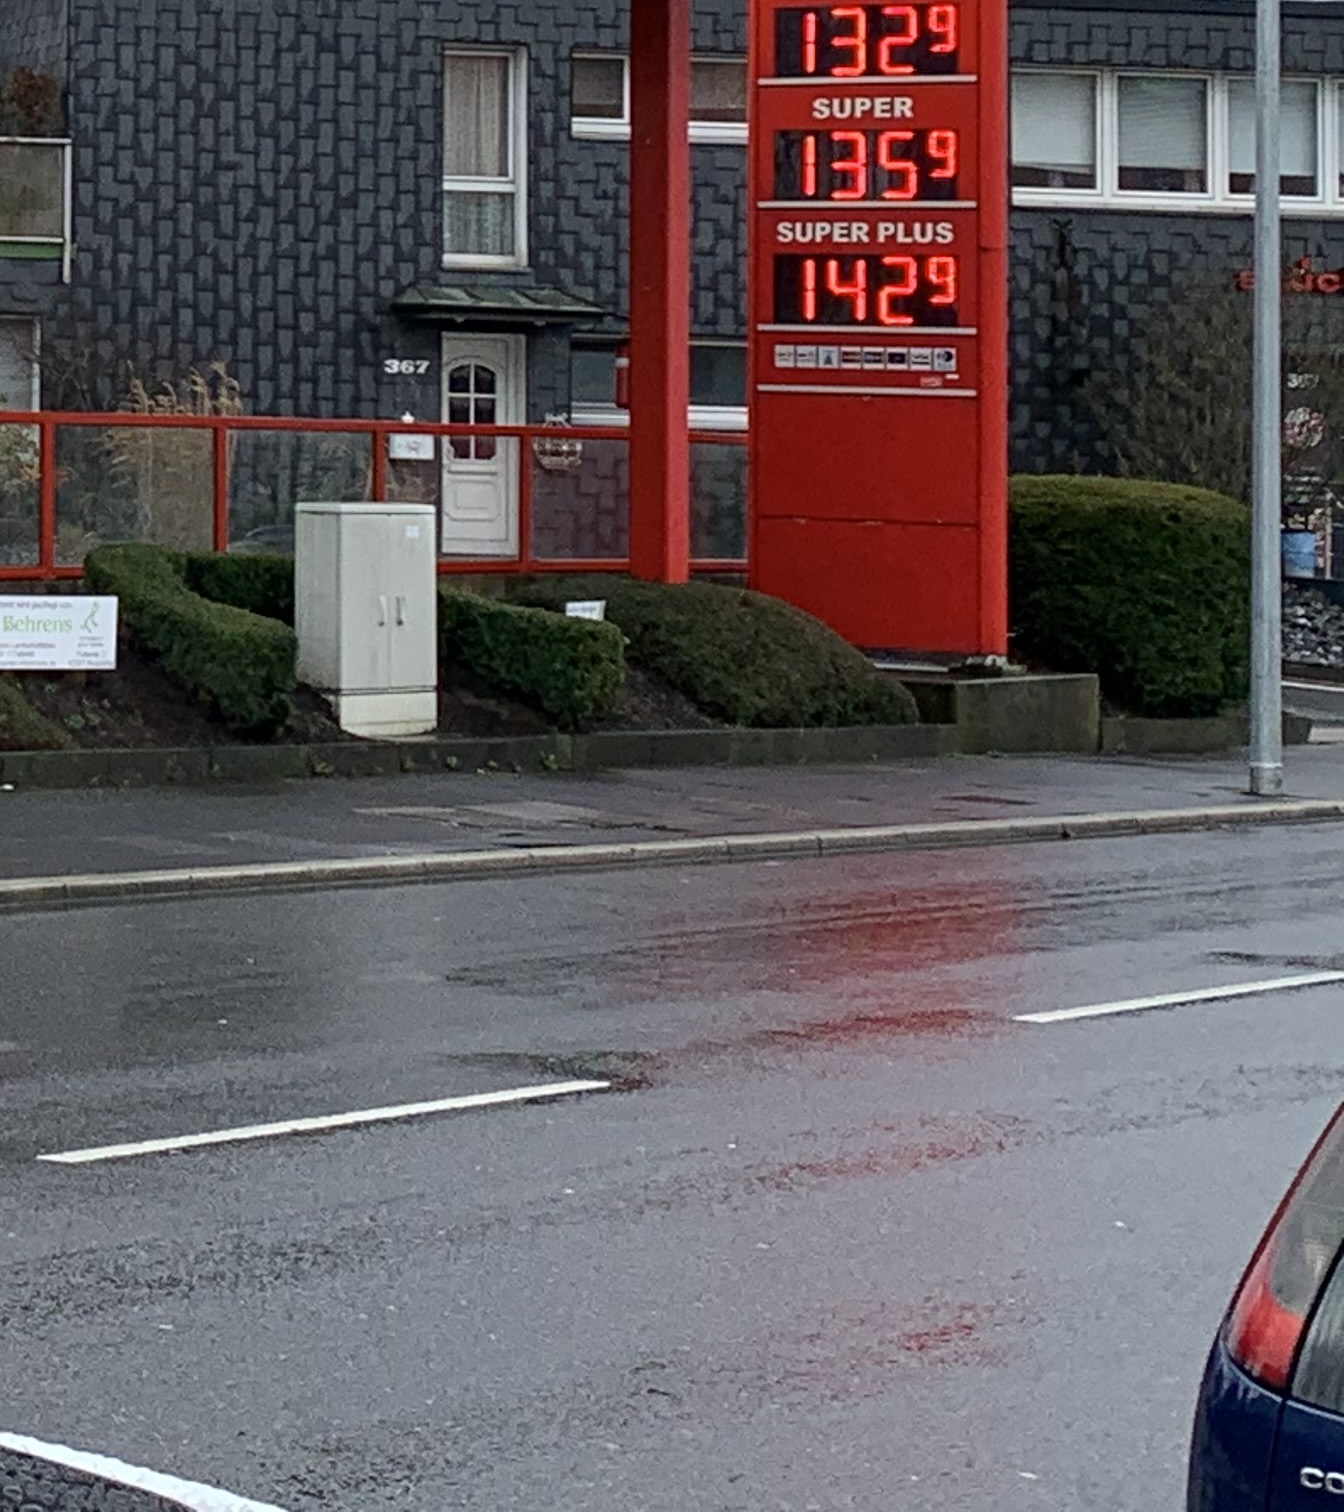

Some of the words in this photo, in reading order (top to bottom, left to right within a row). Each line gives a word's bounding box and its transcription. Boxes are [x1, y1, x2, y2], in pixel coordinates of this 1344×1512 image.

[812, 96, 915, 120] SUPER
[776, 221, 871, 244] SUPER
[876, 222, 955, 244] PLUS
[383, 359, 431, 375] 367
[2, 615, 73, 633] Behrens
